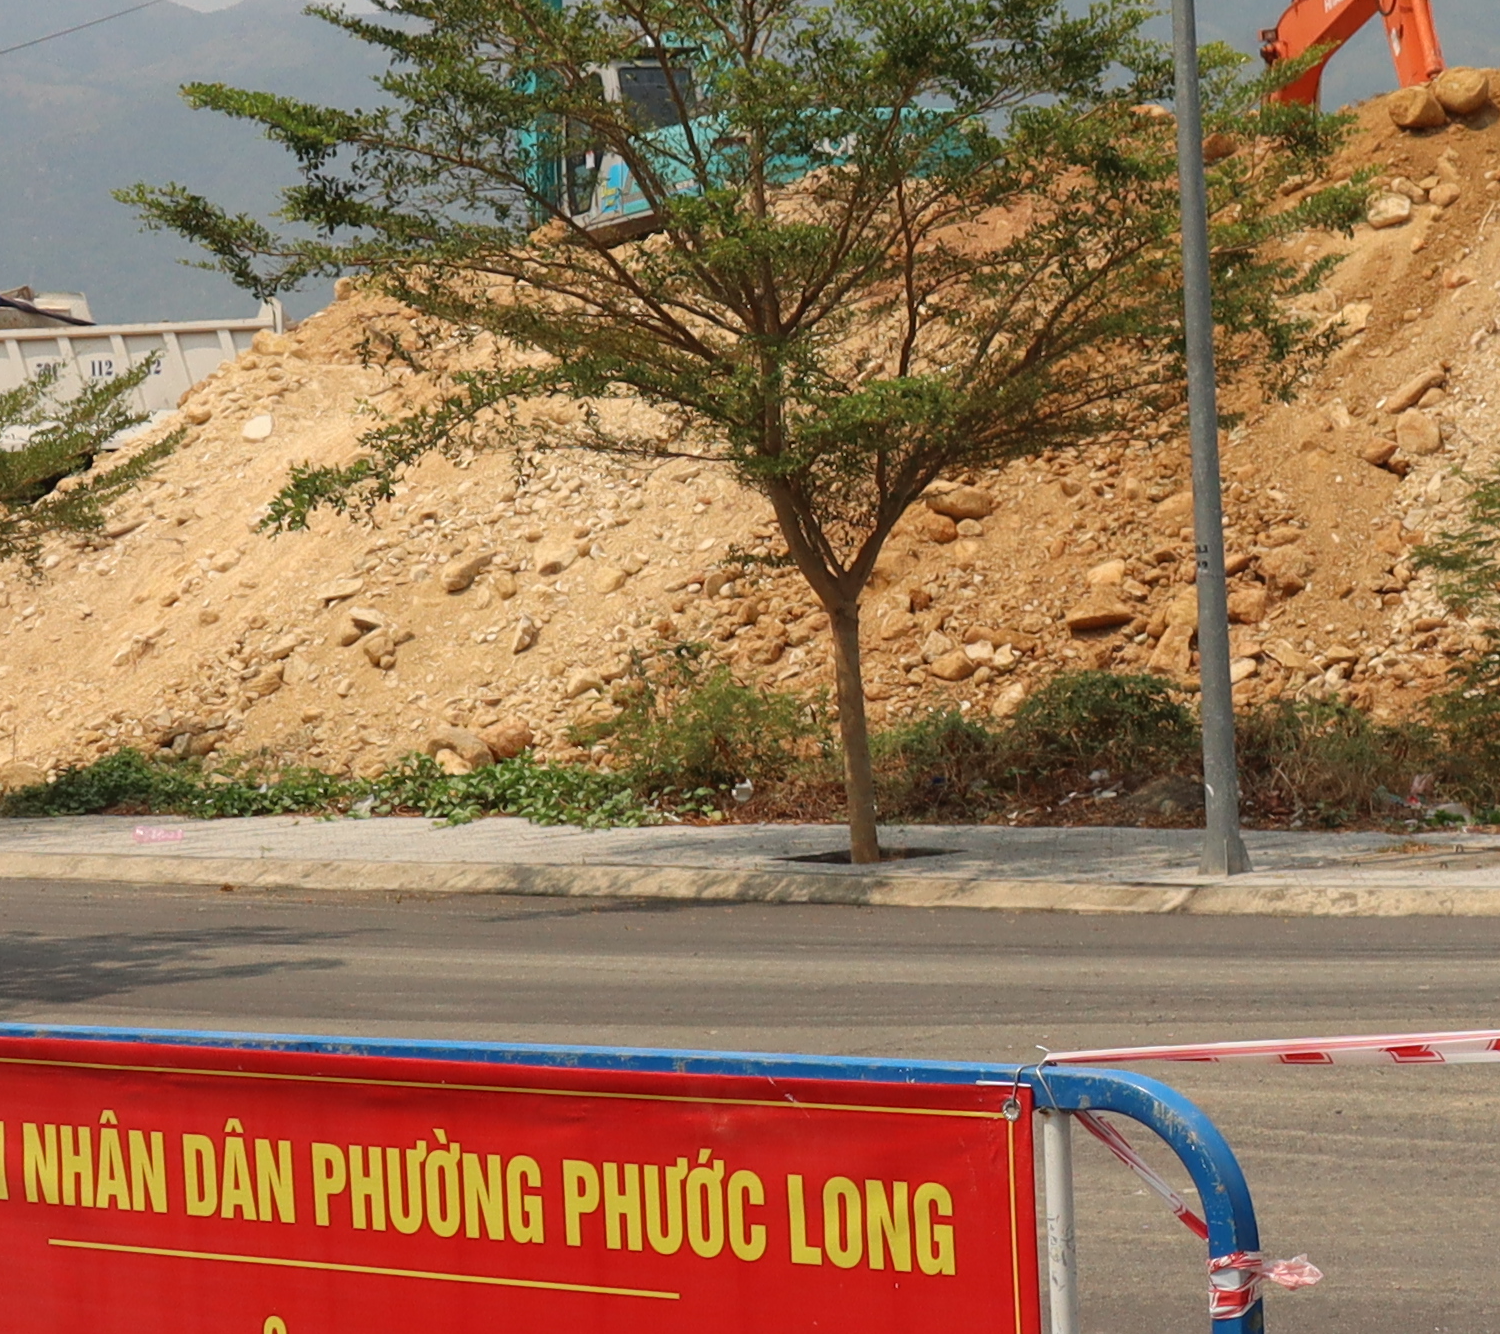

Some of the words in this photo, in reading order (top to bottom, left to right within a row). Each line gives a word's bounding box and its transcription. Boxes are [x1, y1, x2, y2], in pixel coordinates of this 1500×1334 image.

[91, 360, 113, 377] 112
[22, 1109, 168, 1214] NHÂN
[182, 1117, 296, 1224] DÂN
[311, 1128, 544, 1245] PHƯỜNG
[562, 1147, 767, 1263] PHƯỚC
[787, 1174, 957, 1277] LONG
